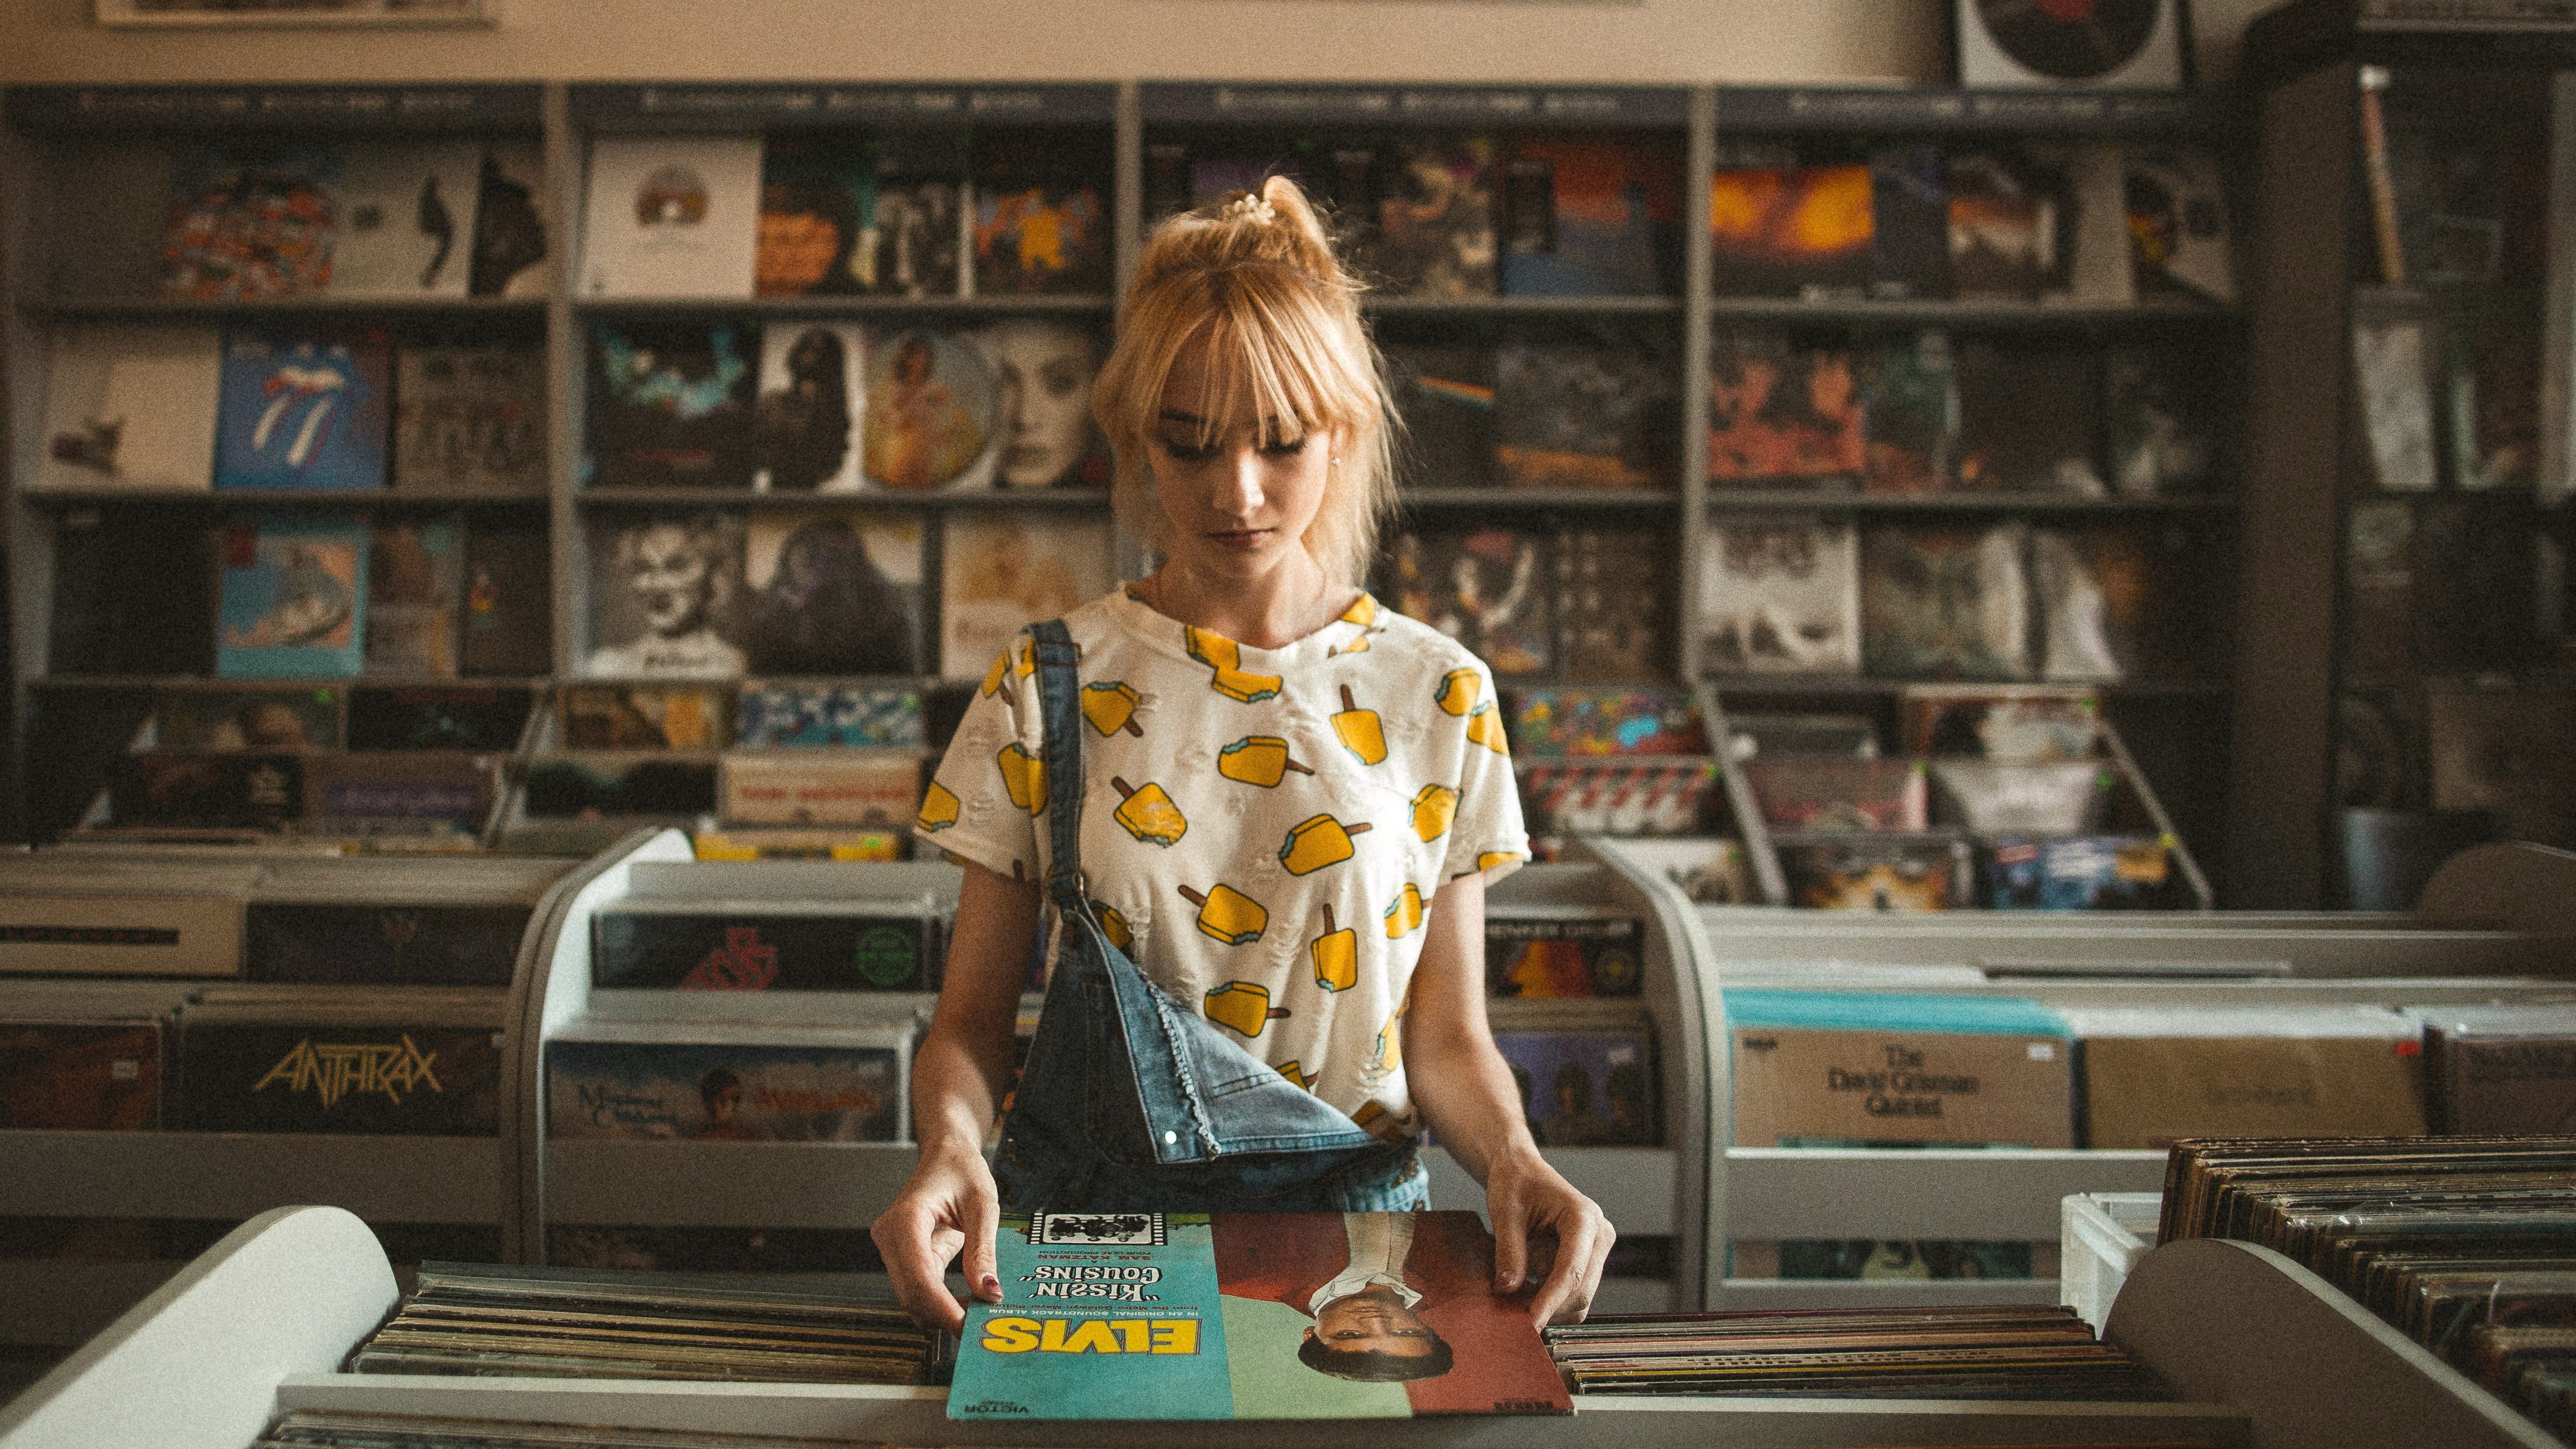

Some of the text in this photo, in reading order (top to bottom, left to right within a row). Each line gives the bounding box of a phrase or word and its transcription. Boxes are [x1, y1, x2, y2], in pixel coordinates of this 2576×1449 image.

[252, 1033, 443, 1109] ANTHRAX
[979, 1317, 1202, 1355] ELVIS
[964, 1405, 1029, 1414] VICTOR
